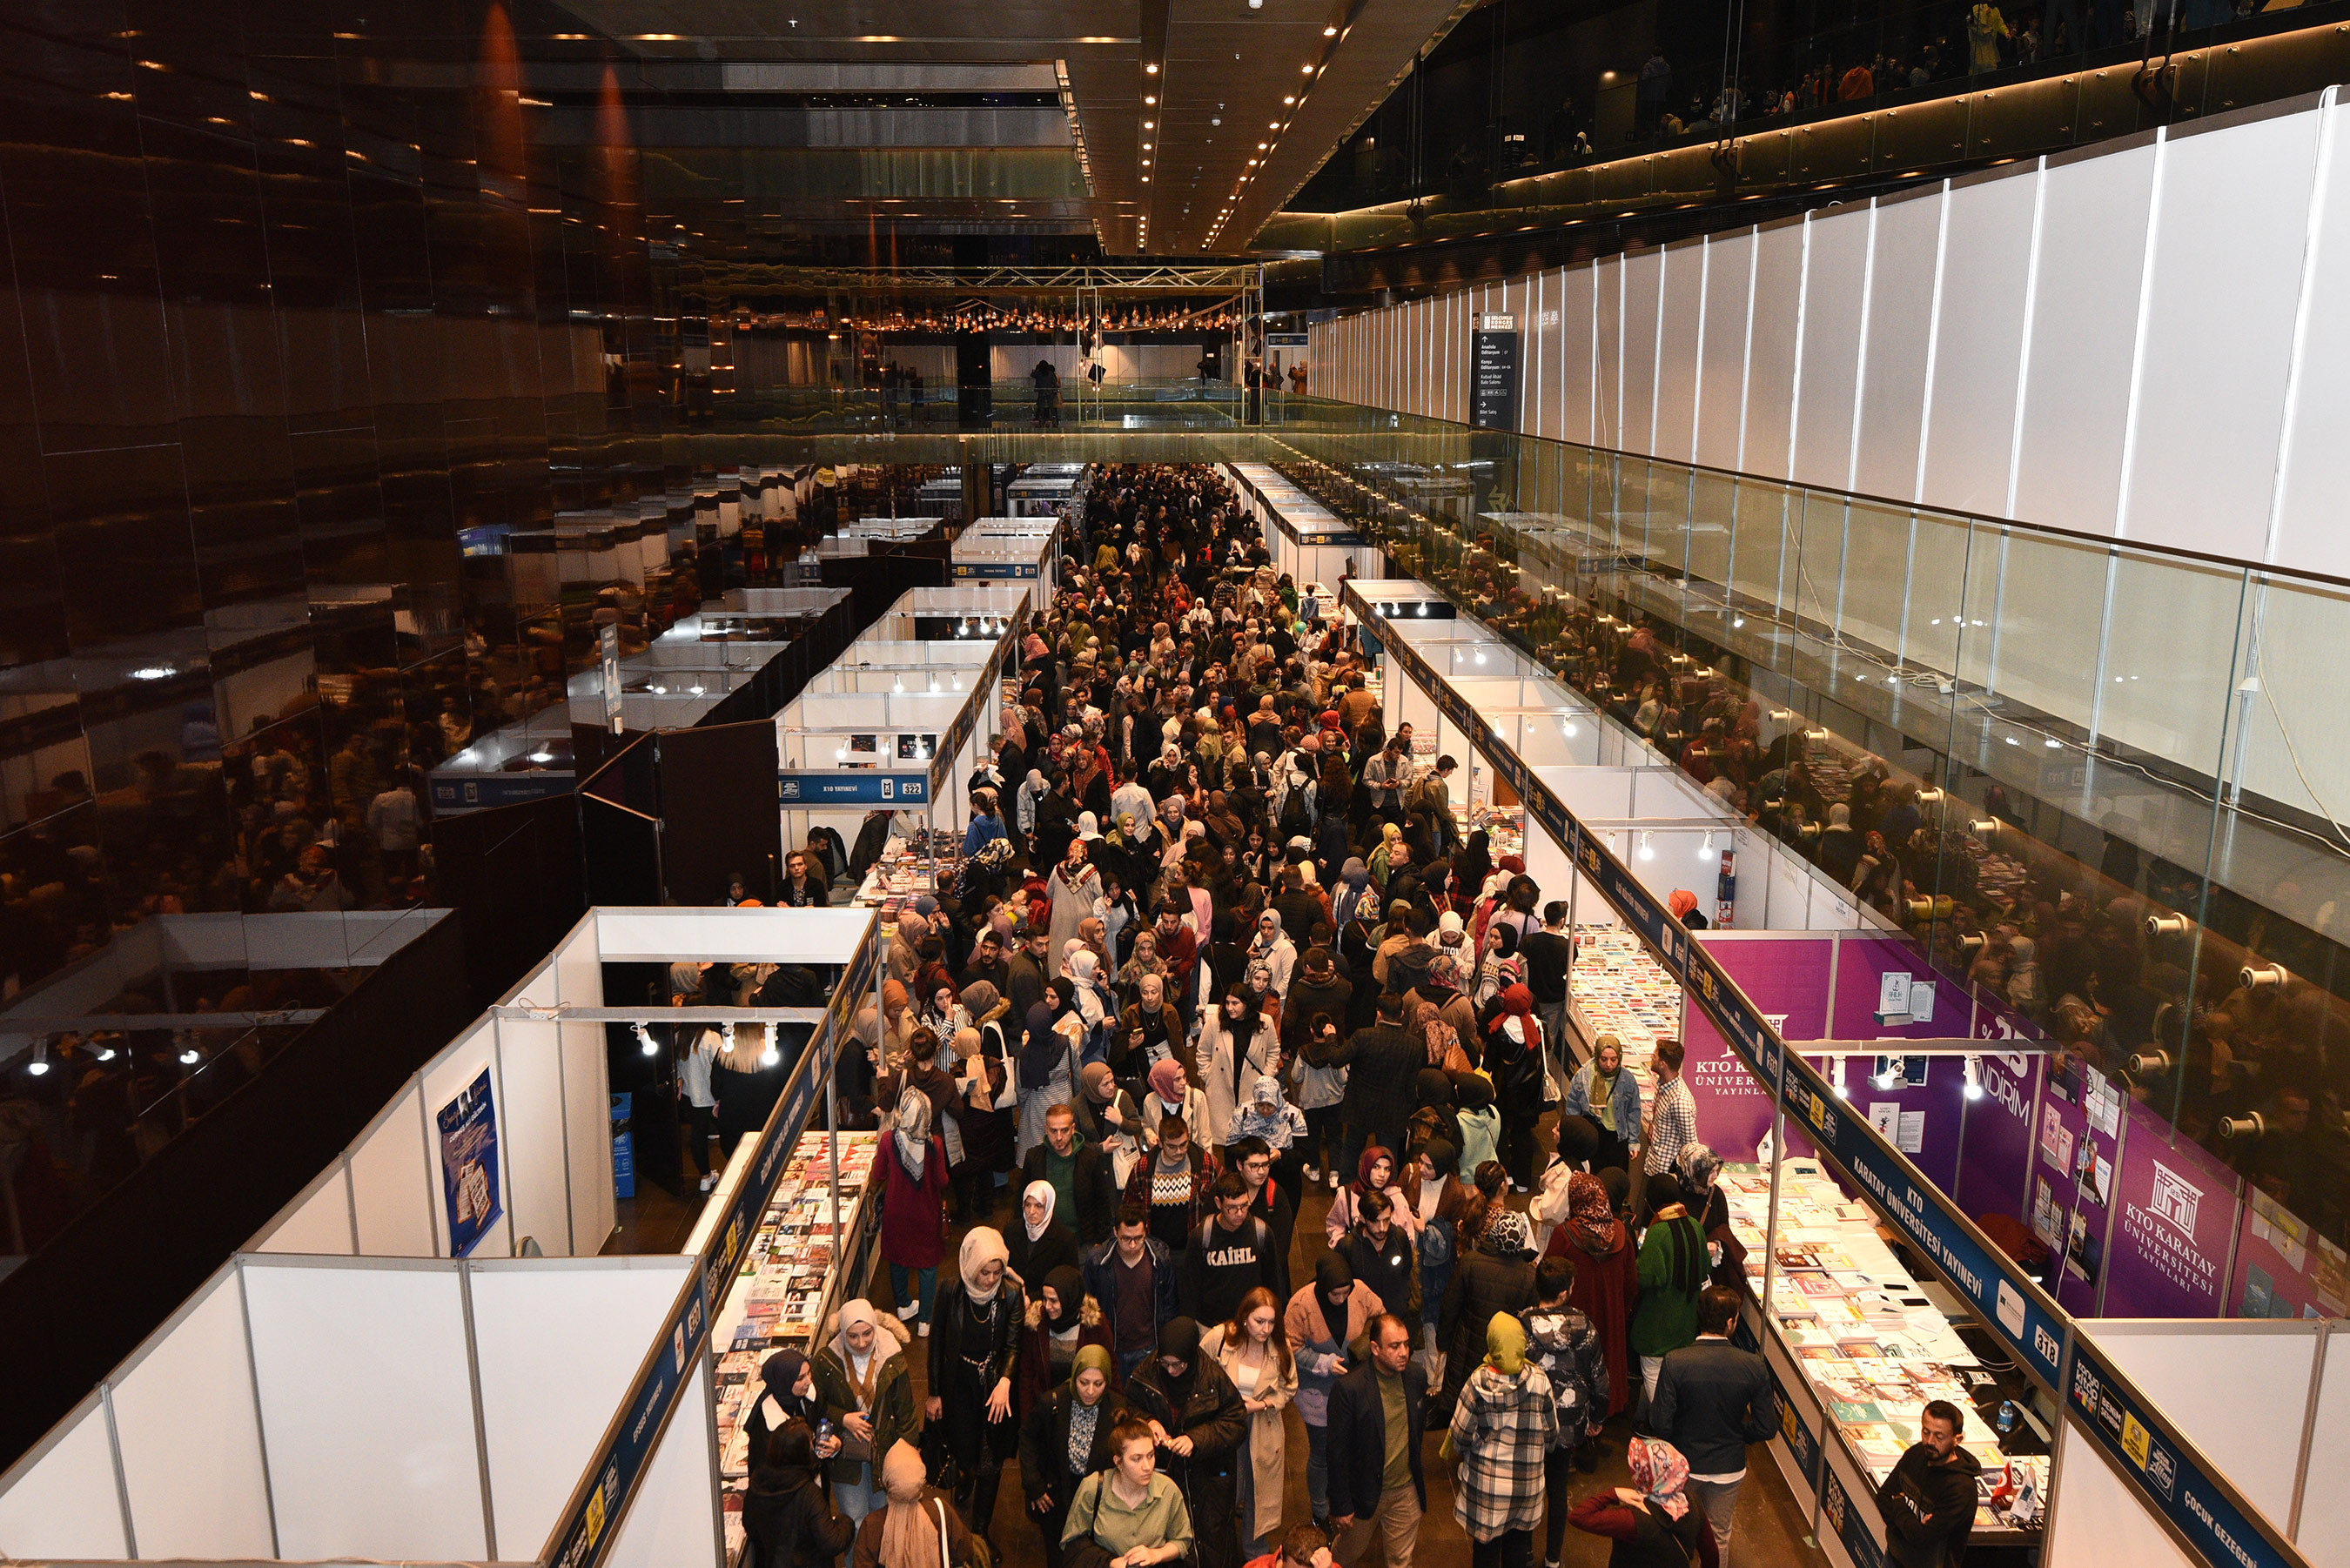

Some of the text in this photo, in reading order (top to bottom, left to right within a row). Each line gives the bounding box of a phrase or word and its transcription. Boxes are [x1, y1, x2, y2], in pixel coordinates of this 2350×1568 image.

[1695, 1062, 1731, 1073] KTO
[1695, 1075, 1759, 1086] ÜNİVER
[1907, 1185, 1924, 1214] KTO
[1854, 1156, 1886, 1199] KARATAY
[1886, 1186, 1942, 1257] ÜNİVERSİTESİ
[1942, 1243, 1983, 1300] YAYINEVİ
[2125, 1202, 2216, 1278] KTO KARATAY
[1206, 1246, 1256, 1266] KAİHL
[2124, 1218, 2213, 1297] ÜNİVERSİTESİ
[2138, 1245, 2191, 1293] YAYINLARI
[2038, 1334, 2056, 1364] 318
[2076, 1369, 2098, 1401] kitap
[2077, 1358, 2099, 1390] konya
[2185, 1491, 2214, 1531] ÇOCUK
